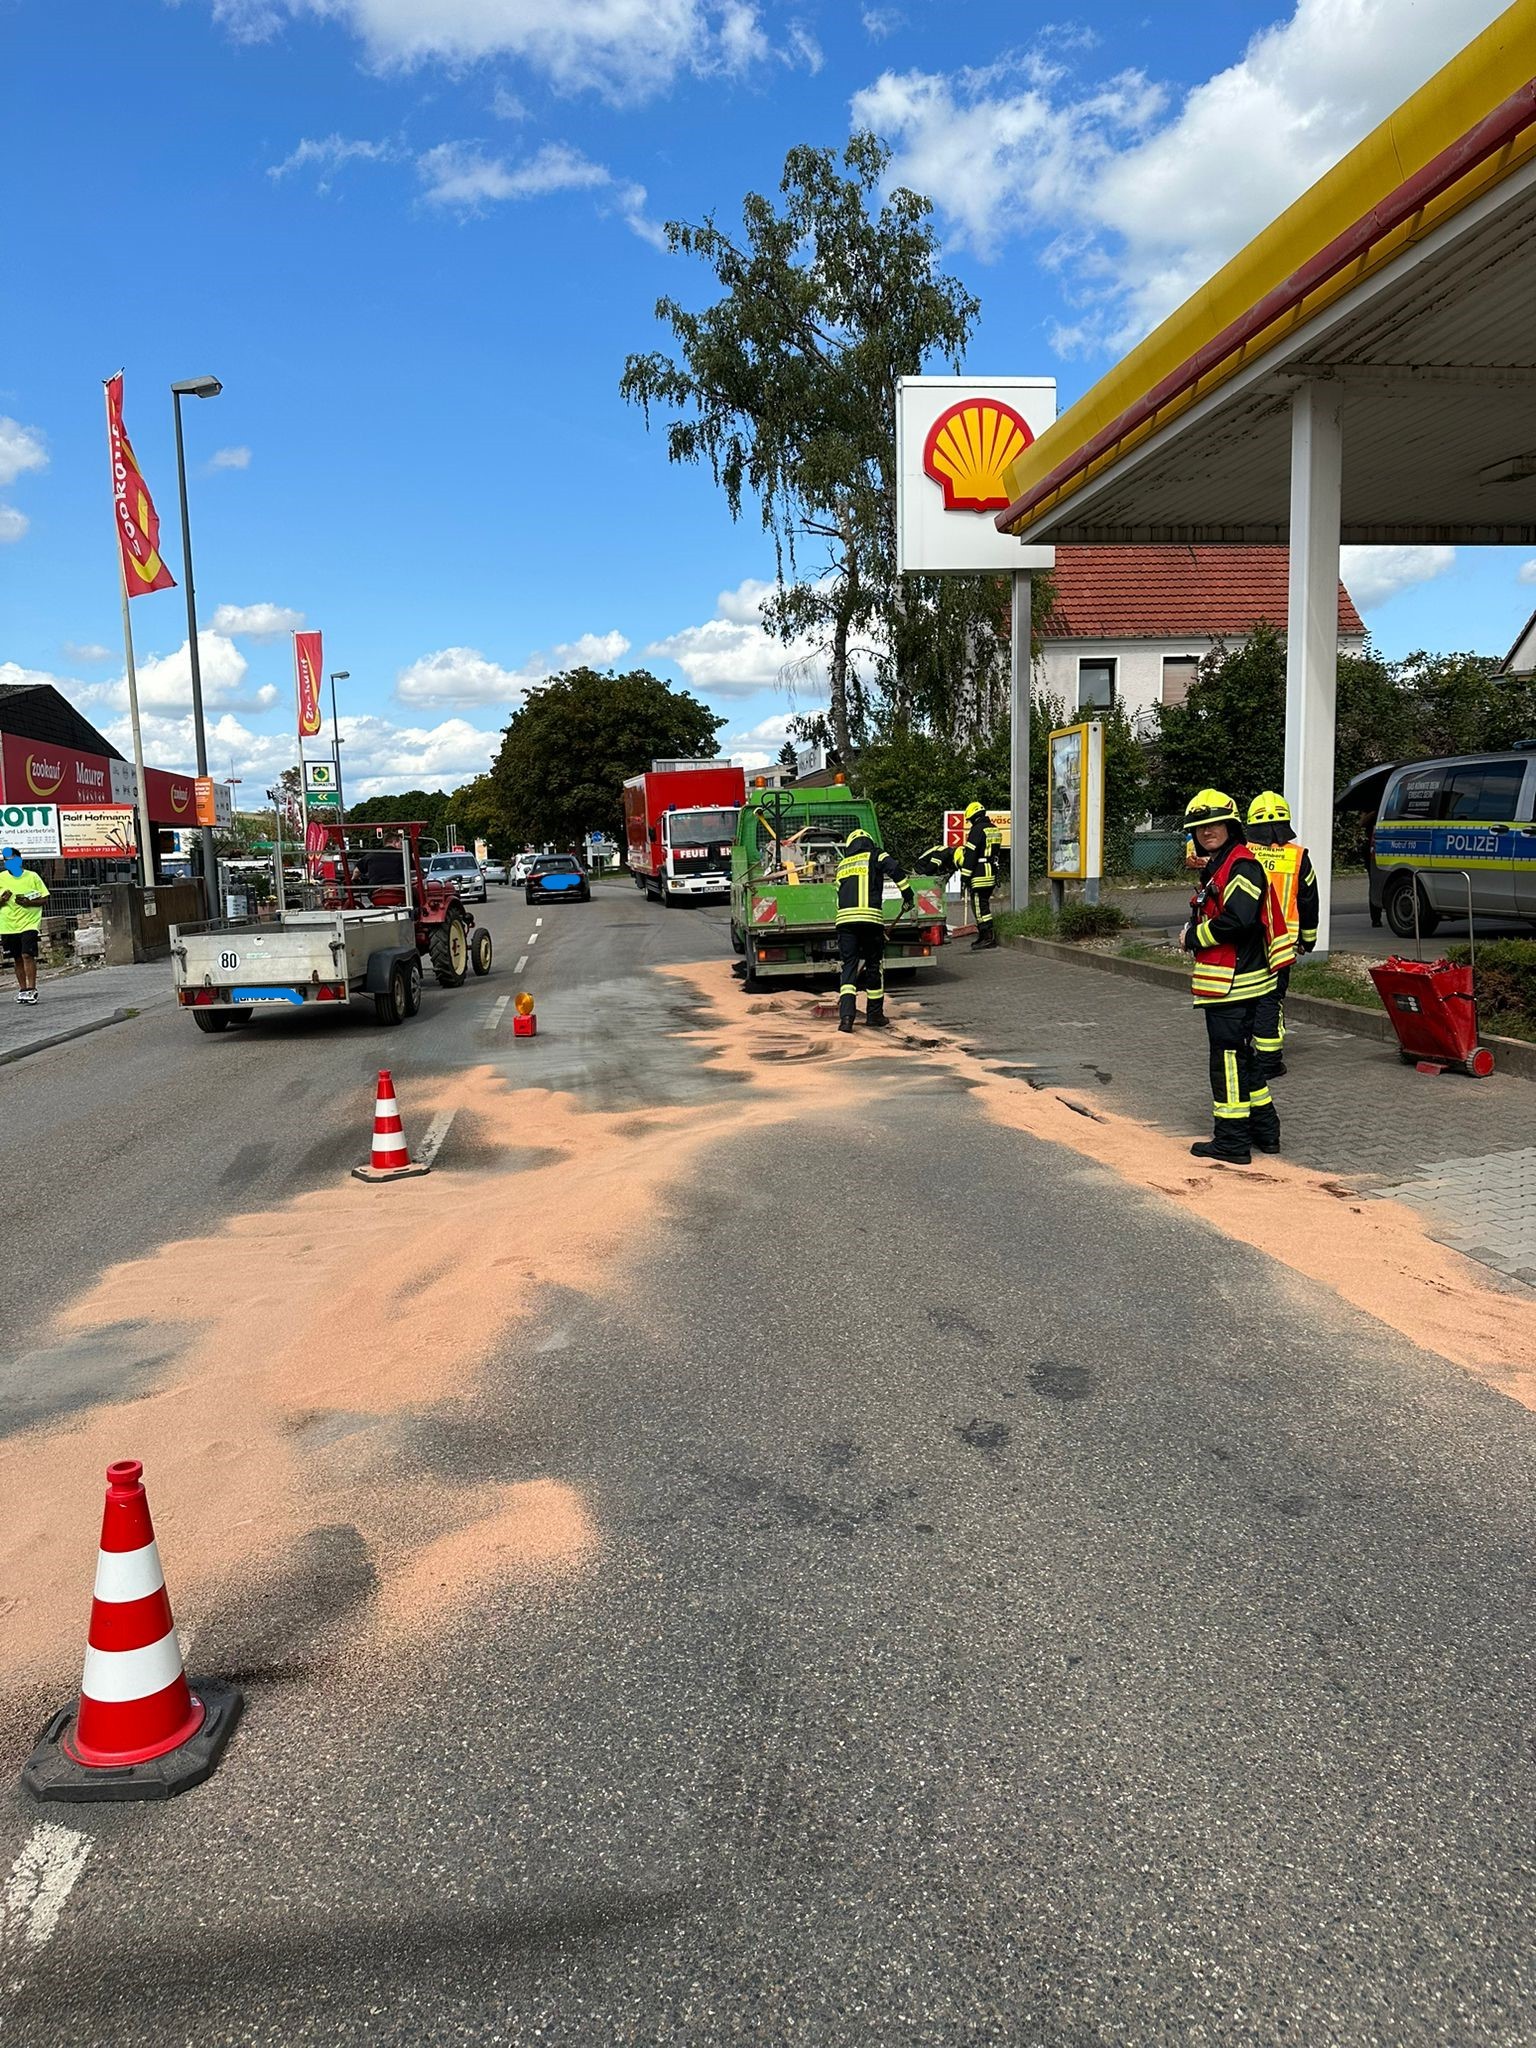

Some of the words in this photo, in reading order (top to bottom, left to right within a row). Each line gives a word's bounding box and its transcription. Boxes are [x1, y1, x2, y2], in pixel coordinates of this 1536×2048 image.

[75, 760, 105, 788] Maurer
[1446, 834, 1499, 853] POLIZEI
[221, 953, 237, 968] 80
